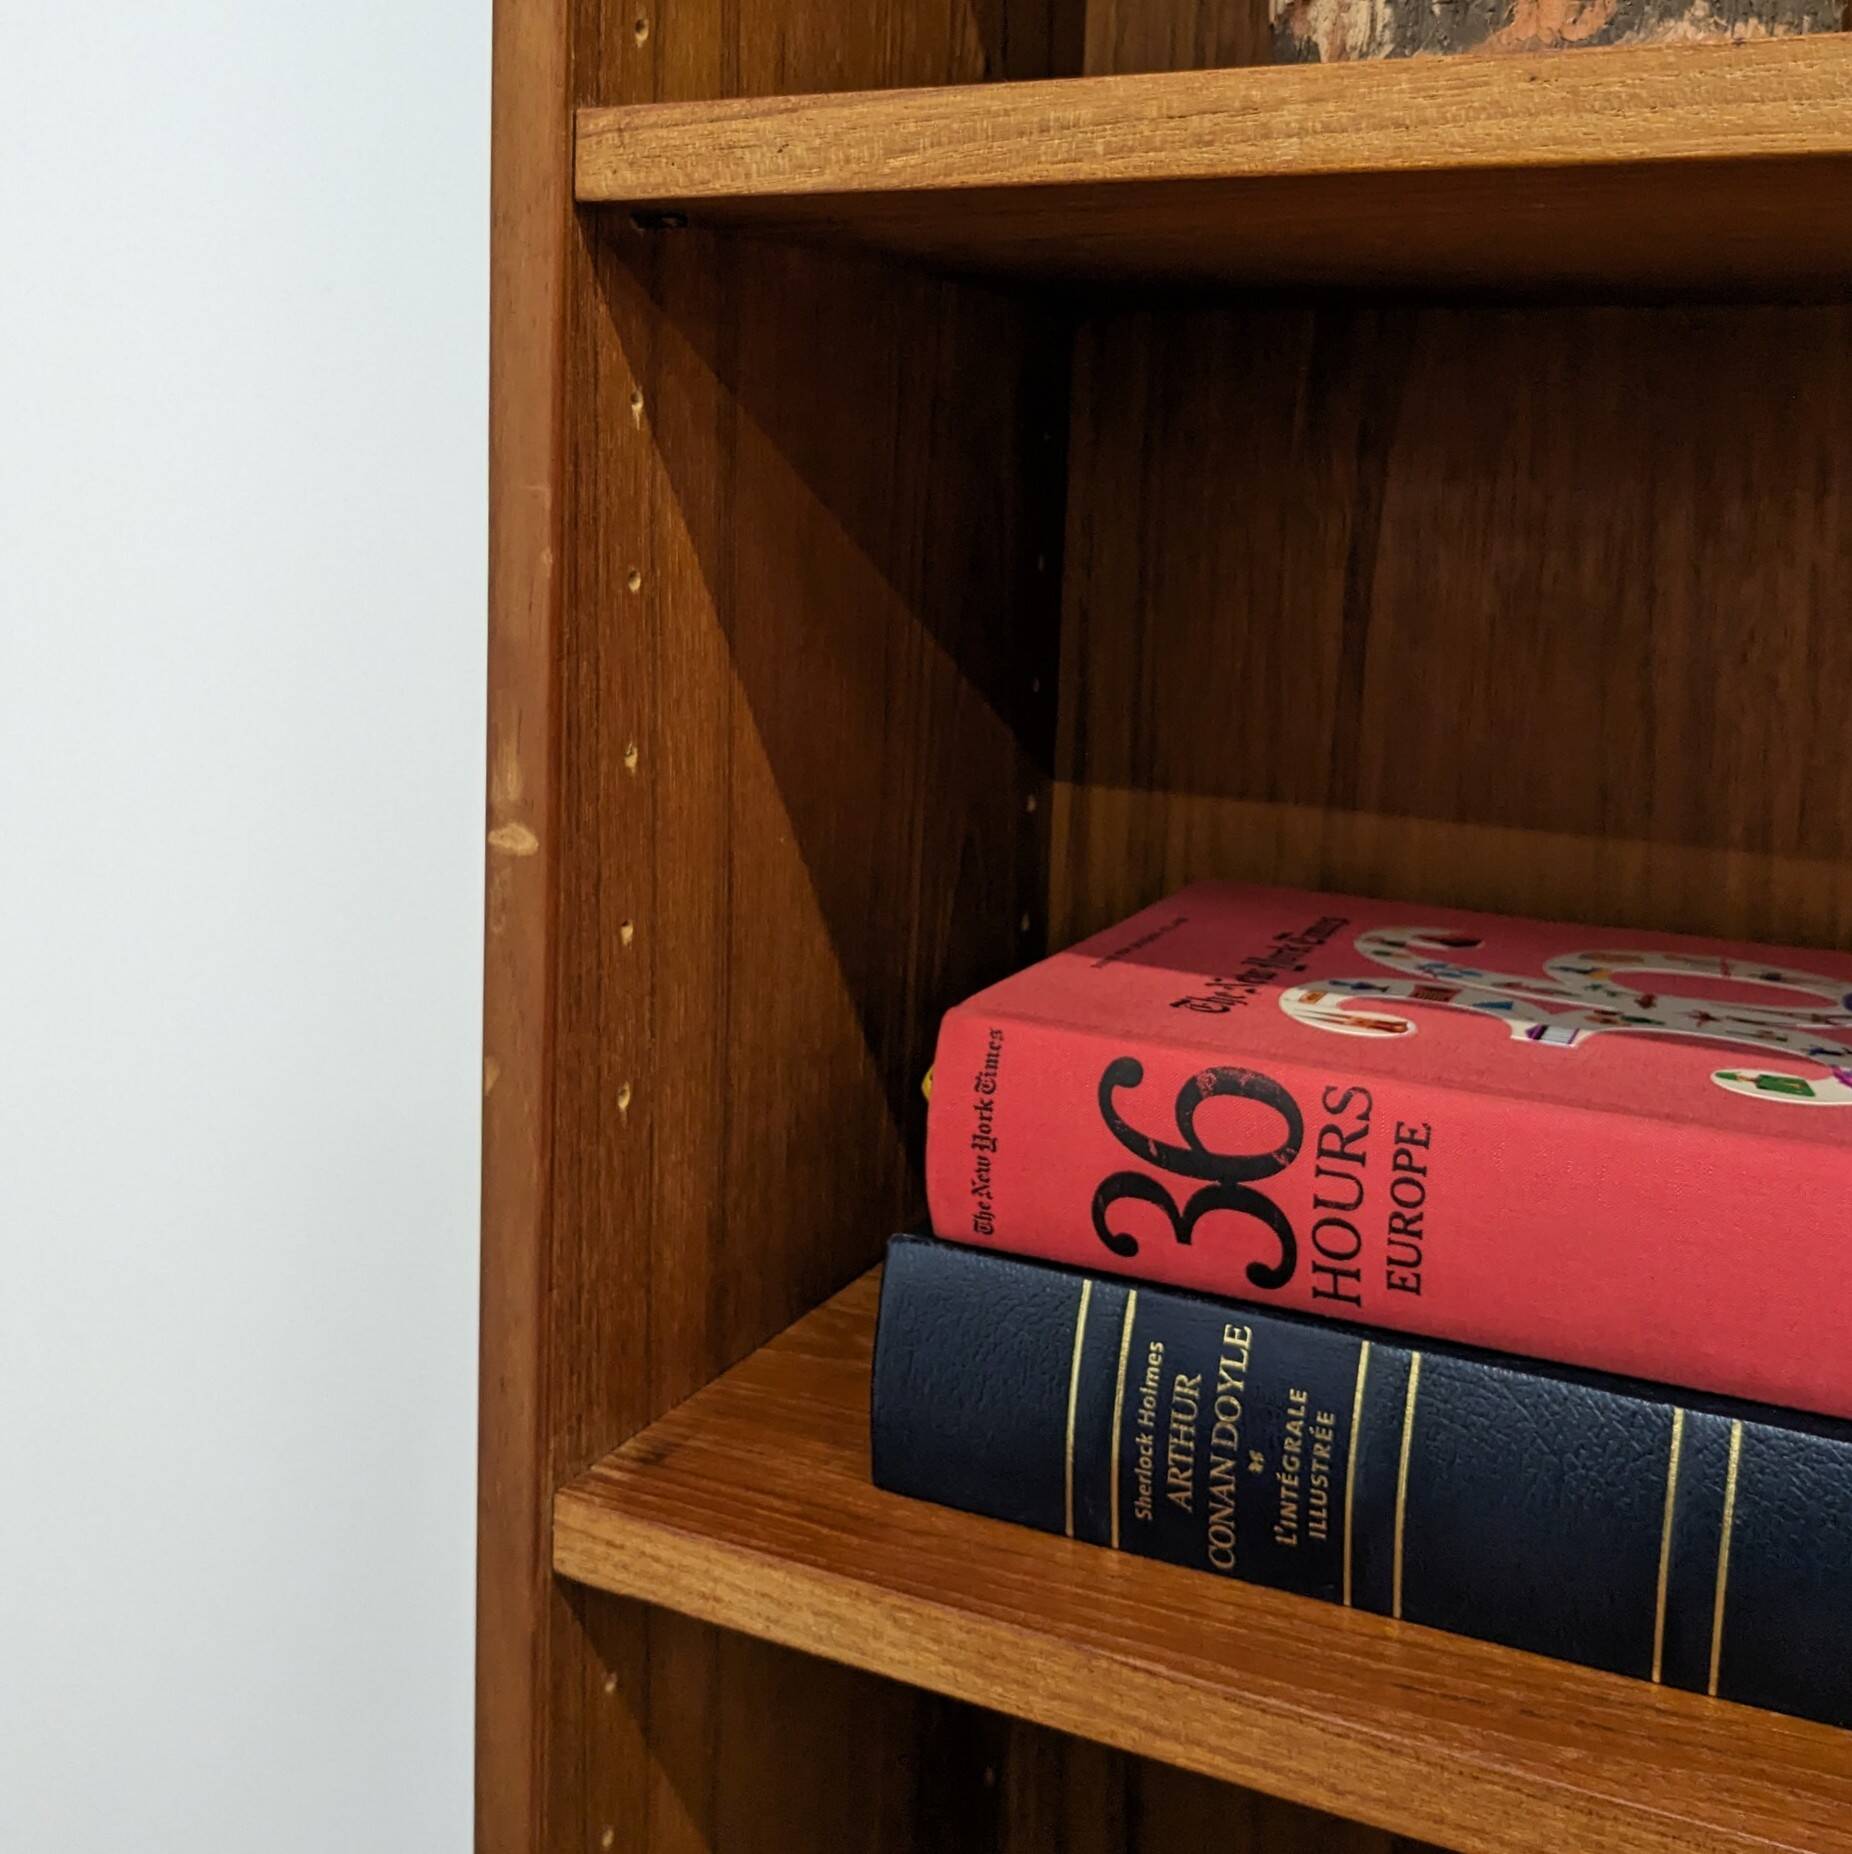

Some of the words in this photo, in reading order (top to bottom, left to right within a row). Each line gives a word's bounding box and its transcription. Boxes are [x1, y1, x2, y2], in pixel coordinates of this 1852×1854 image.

[974, 1028, 1004, 1096] Times
[971, 1098, 998, 1153] York
[971, 1155, 993, 1201] New
[1091, 1056, 1304, 1290] 36
[974, 1201, 996, 1236] The
[1311, 1085, 1373, 1308] HOURS
[1386, 1120, 1432, 1297] EUROPE
[1138, 1340, 1165, 1428] Holmes
[1167, 1373, 1203, 1514] ARTHUR
[1210, 1322, 1254, 1452] DOYLE
[1134, 1432, 1156, 1522] Sherlock
[1208, 1453, 1238, 1571] CONAN
[1274, 1387, 1309, 1547] L'INTÉGRALE
[1308, 1410, 1337, 1541] ILLUSTRÉE
